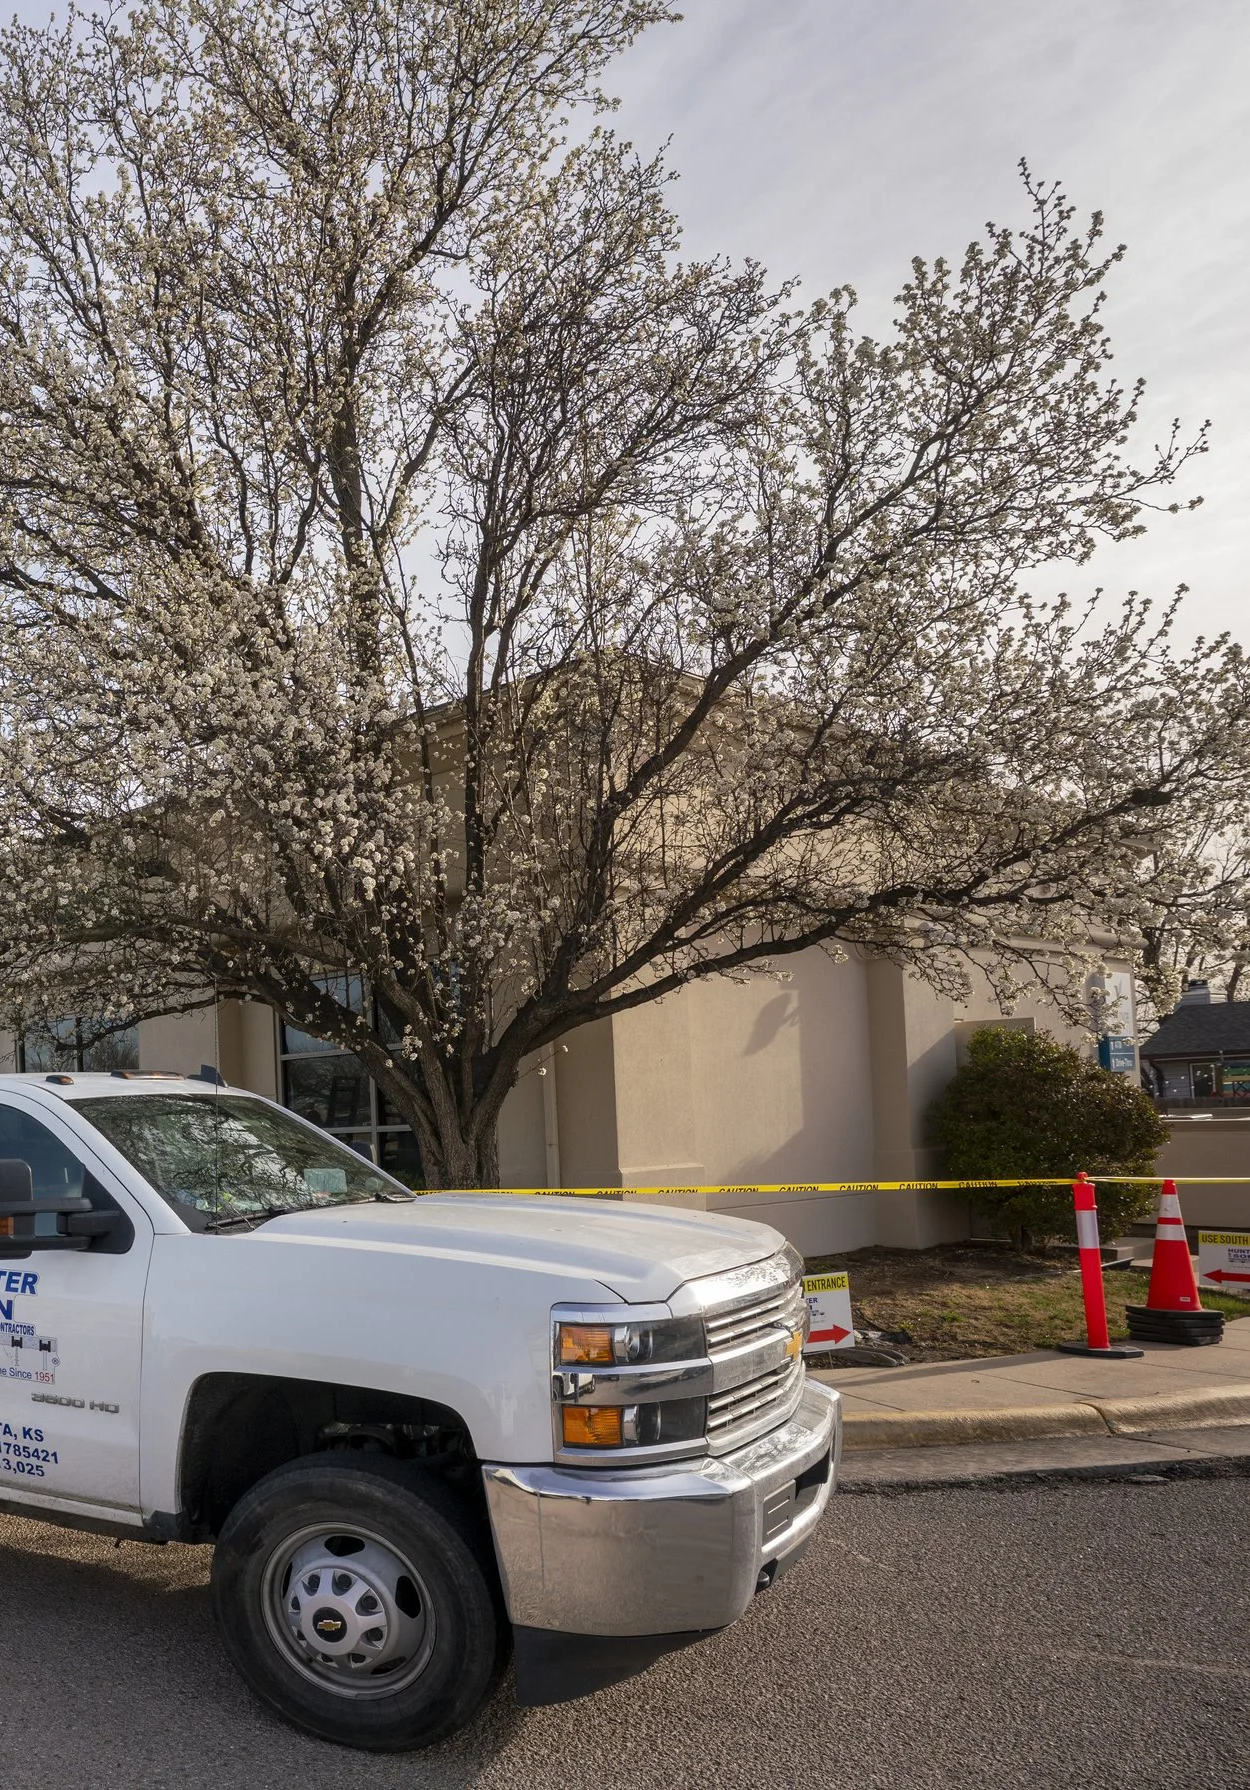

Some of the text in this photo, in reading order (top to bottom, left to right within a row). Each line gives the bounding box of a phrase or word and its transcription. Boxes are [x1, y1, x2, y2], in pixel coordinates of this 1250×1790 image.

[1202, 1234, 1248, 1245] USE SOUTH
[807, 1276, 846, 1291] ENTRANCE
[9, 1368, 32, 1379] Since
[34, 1371, 55, 1383] 1951
[31, 1393, 120, 1413] 3500 HD
[22, 1427, 44, 1442] KS
